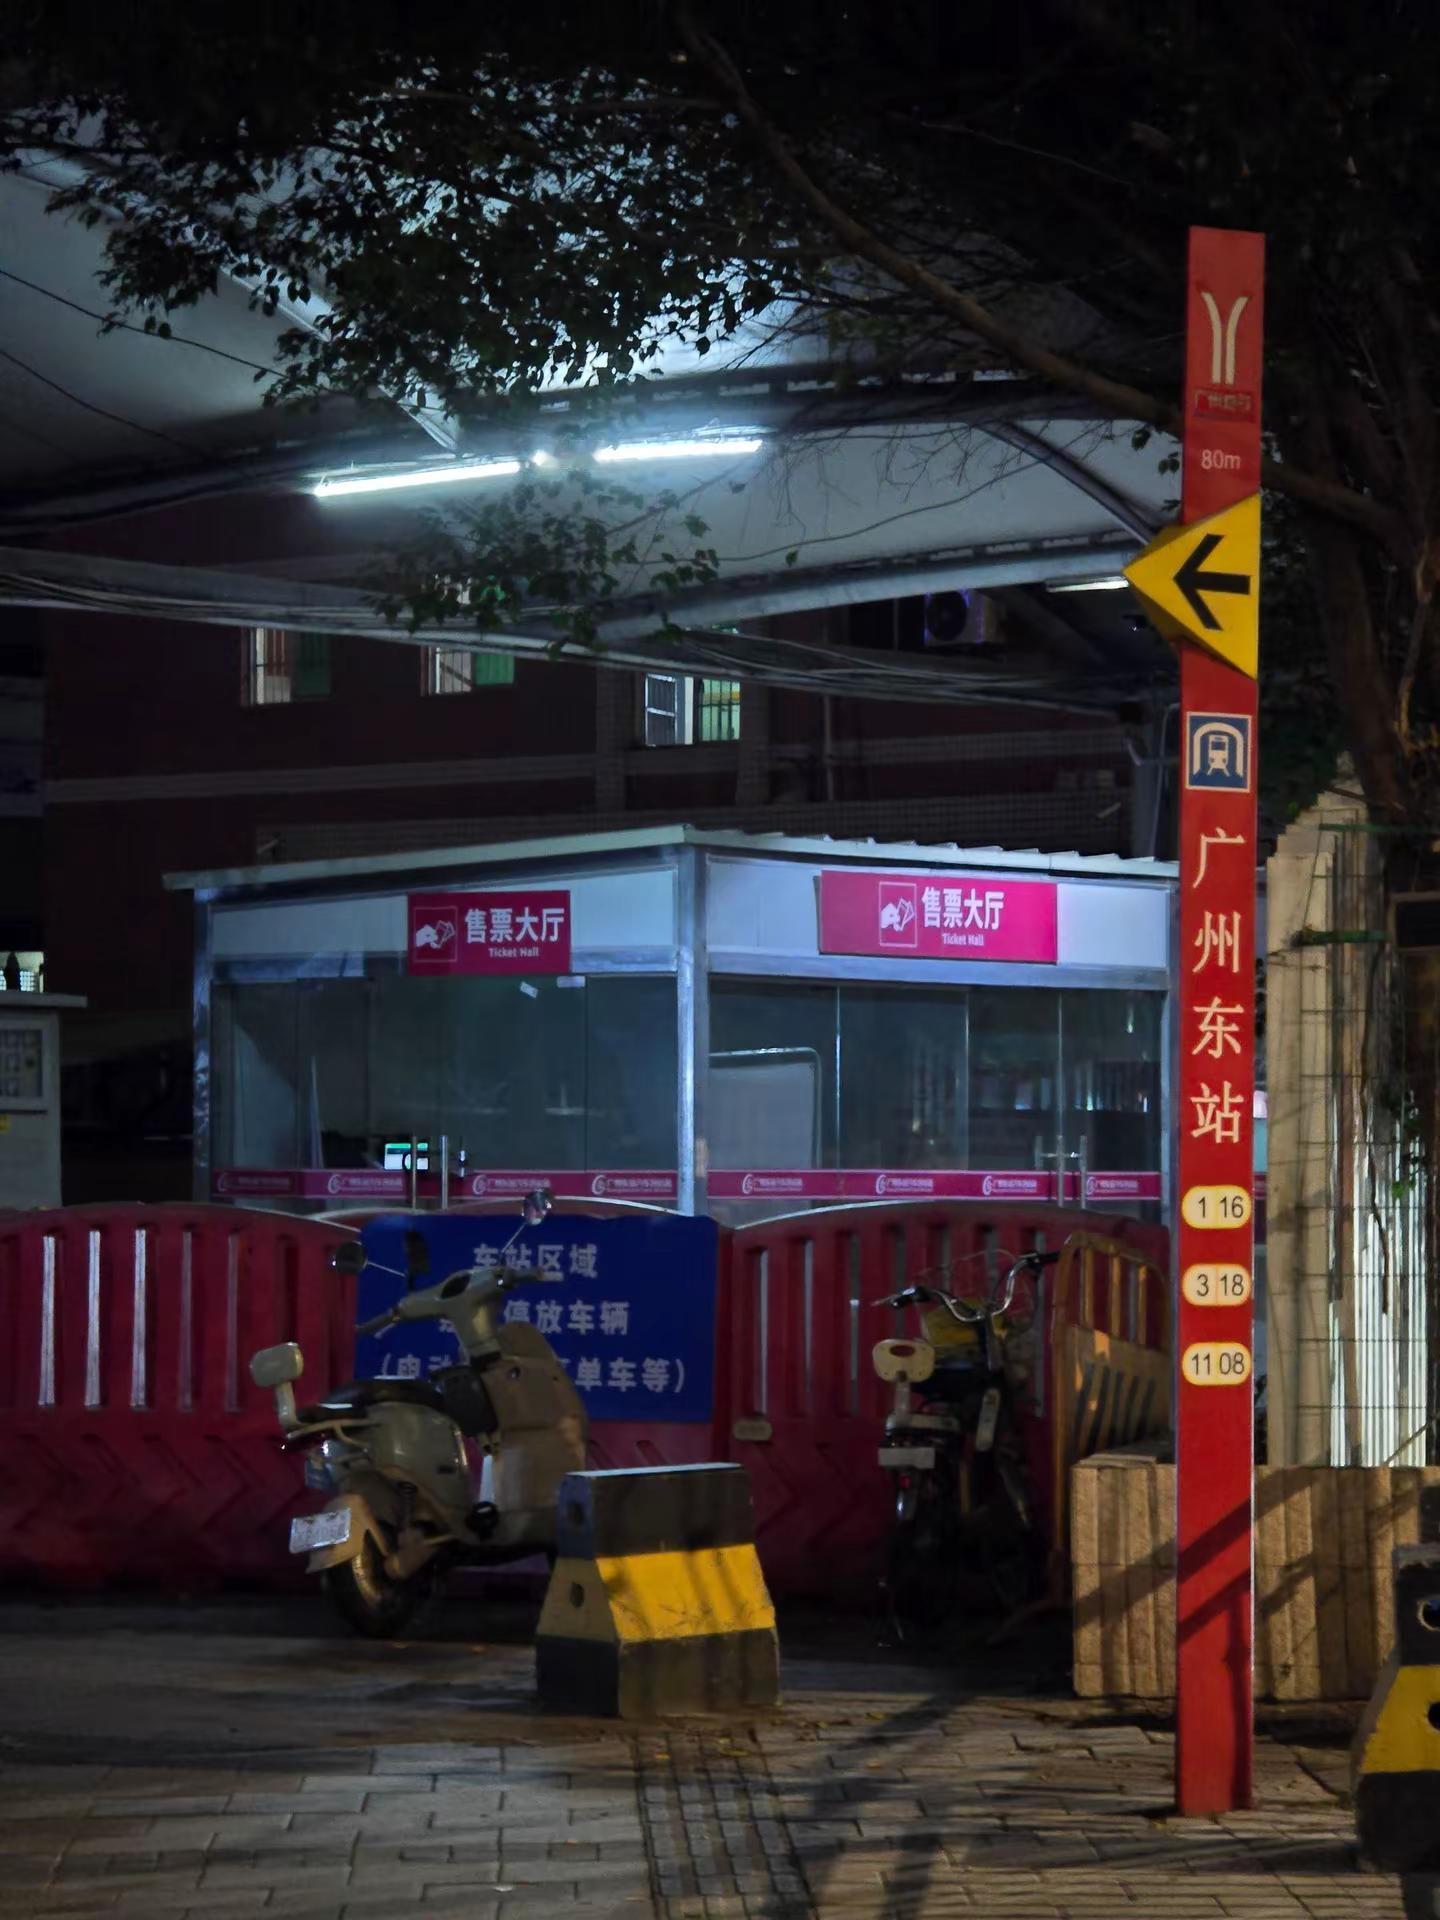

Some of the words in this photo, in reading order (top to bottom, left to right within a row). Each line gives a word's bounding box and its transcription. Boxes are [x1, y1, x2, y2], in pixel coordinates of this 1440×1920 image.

[1201, 449, 1241, 470] 80m
[465, 906, 565, 943] 售票大厅
[921, 886, 1005, 930] 售票大厅
[488, 947, 518, 958] Ticket
[519, 947, 540, 958] Hall
[942, 932, 967, 946] Ticket
[968, 933, 985, 947] Hall
[1190, 827, 1246, 1144] 广州东站
[473, 1243, 598, 1281] 车站区域
